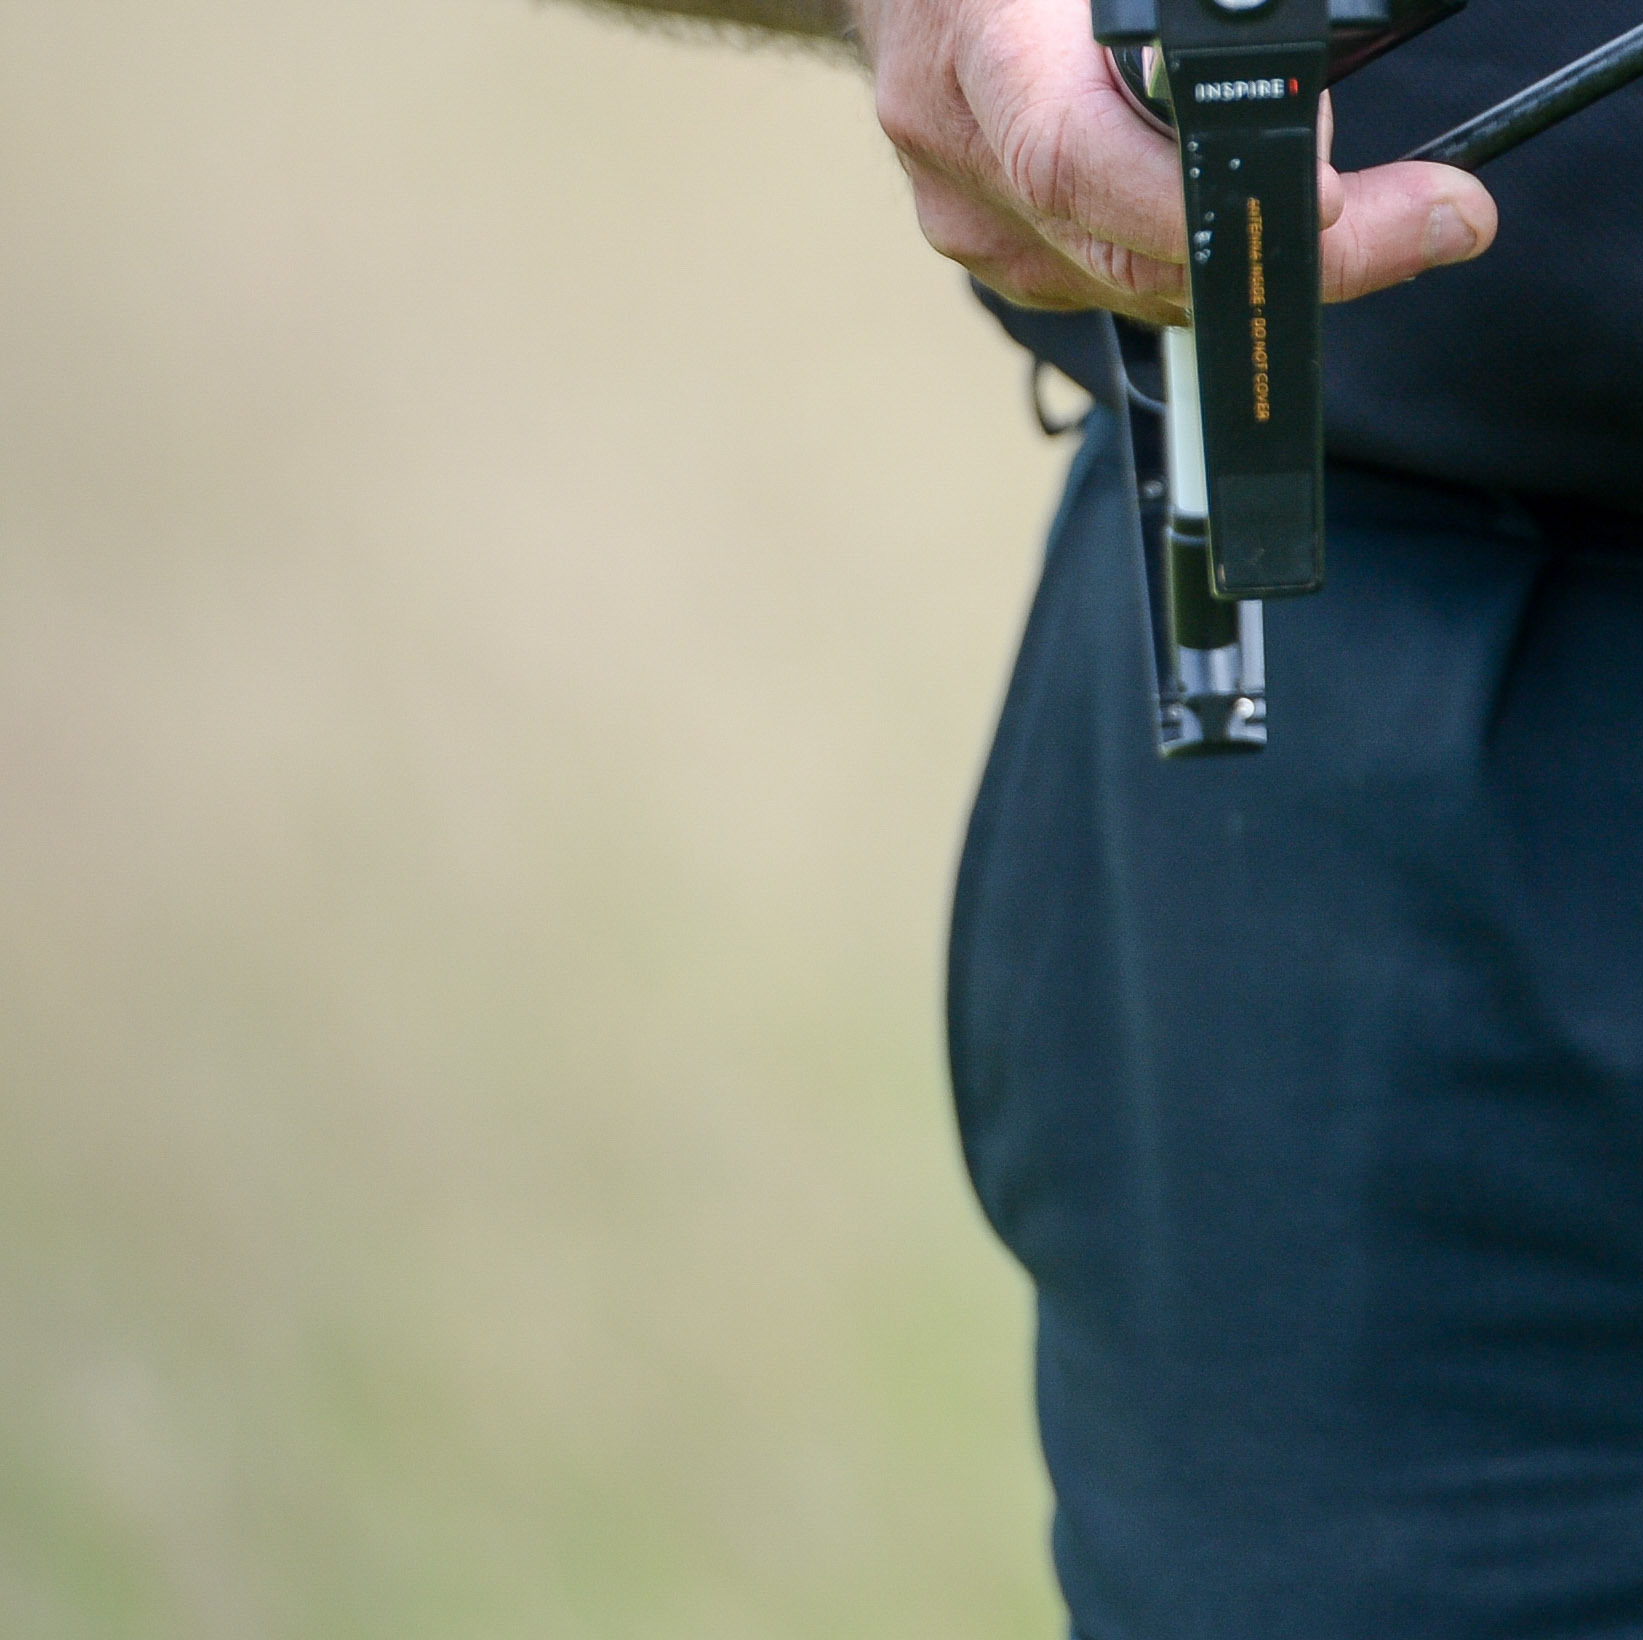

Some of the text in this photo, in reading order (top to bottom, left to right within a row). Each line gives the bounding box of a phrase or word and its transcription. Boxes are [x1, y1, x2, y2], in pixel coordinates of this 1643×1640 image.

[1195, 78, 1285, 102] INSPIRE
[1247, 196, 1262, 260] ANTENNA
[1249, 262, 1266, 306] INSIDE
[1251, 317, 1267, 340] DO
[1252, 341, 1268, 371] NOT
[1254, 372, 1270, 422] COVER
